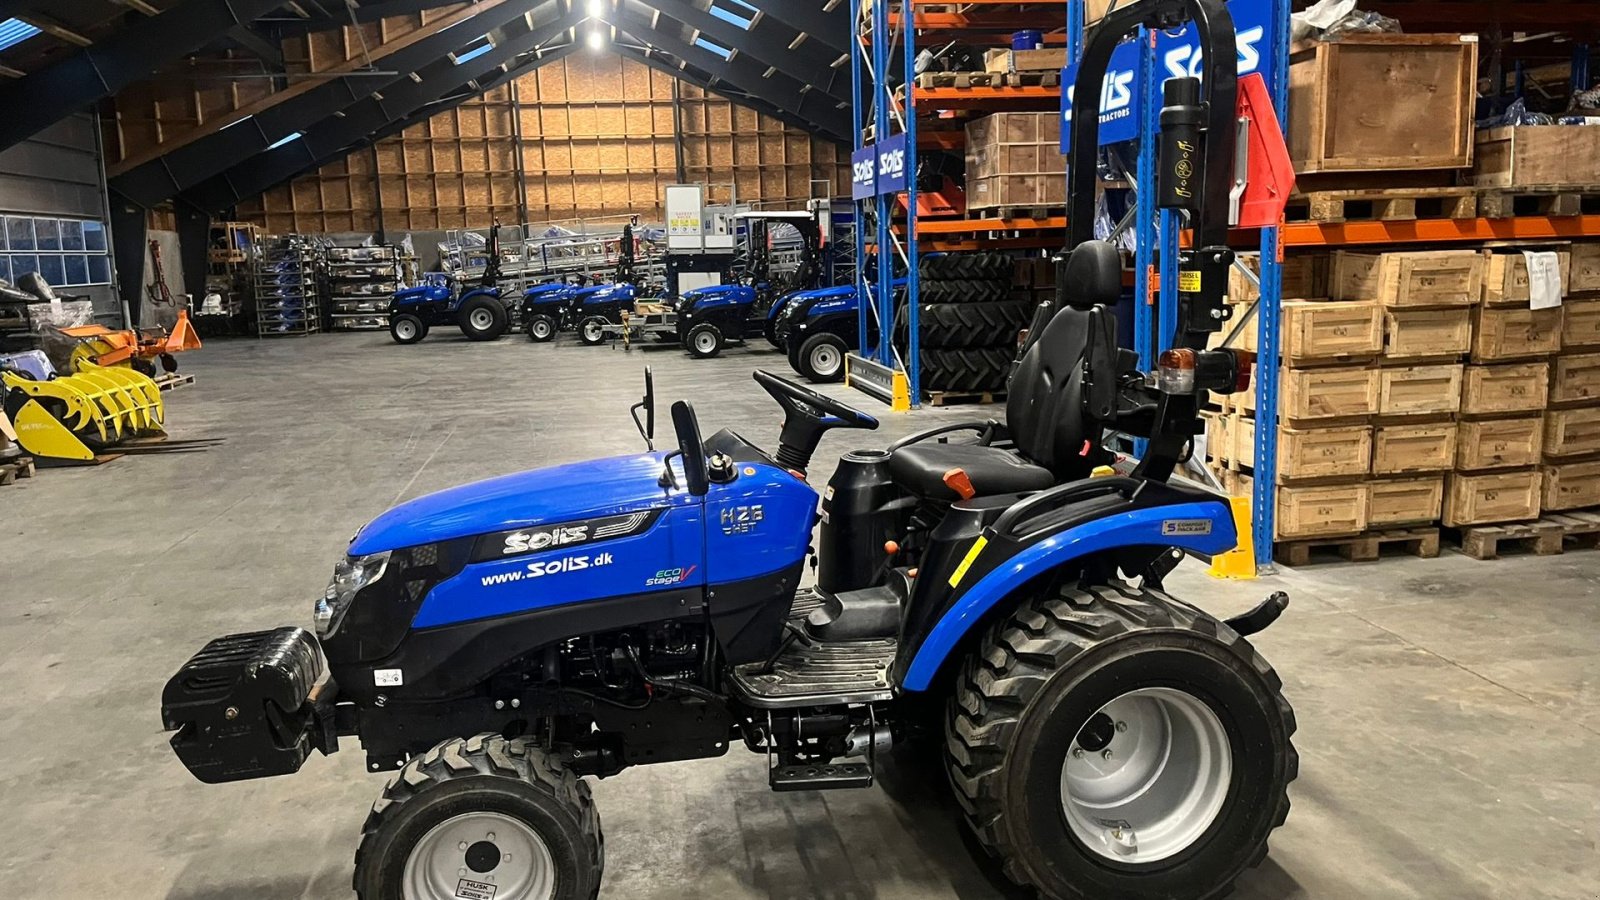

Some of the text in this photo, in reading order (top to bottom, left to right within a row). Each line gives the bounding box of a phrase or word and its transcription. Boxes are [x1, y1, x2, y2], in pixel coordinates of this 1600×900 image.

[1098, 107, 1130, 124] TRACTORS
[655, 567, 682, 578] ECO
[466, 882, 489, 890] HUSK
